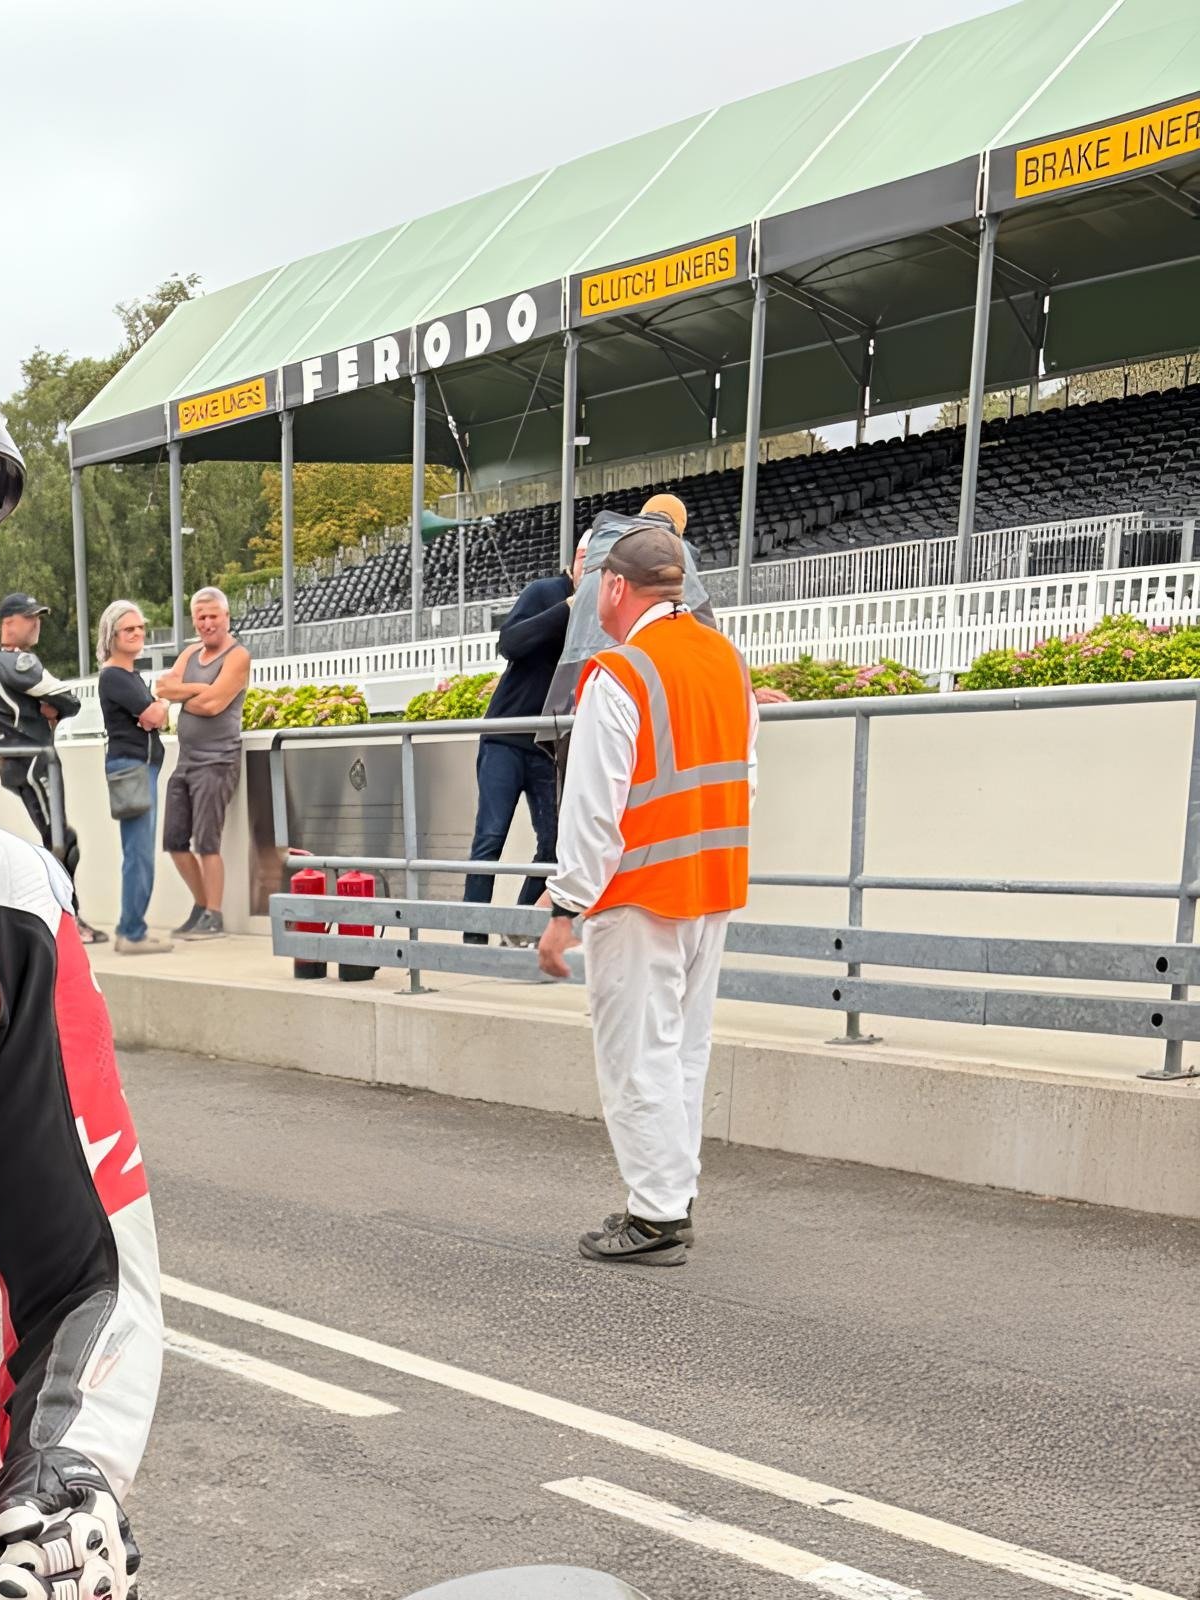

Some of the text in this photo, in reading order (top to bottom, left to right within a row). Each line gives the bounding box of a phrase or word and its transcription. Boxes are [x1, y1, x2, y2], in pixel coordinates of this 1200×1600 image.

[1024, 136, 1111, 187] BRAKE
[588, 247, 729, 307] CLUTCH LINERS
[302, 292, 538, 405] FERODO
